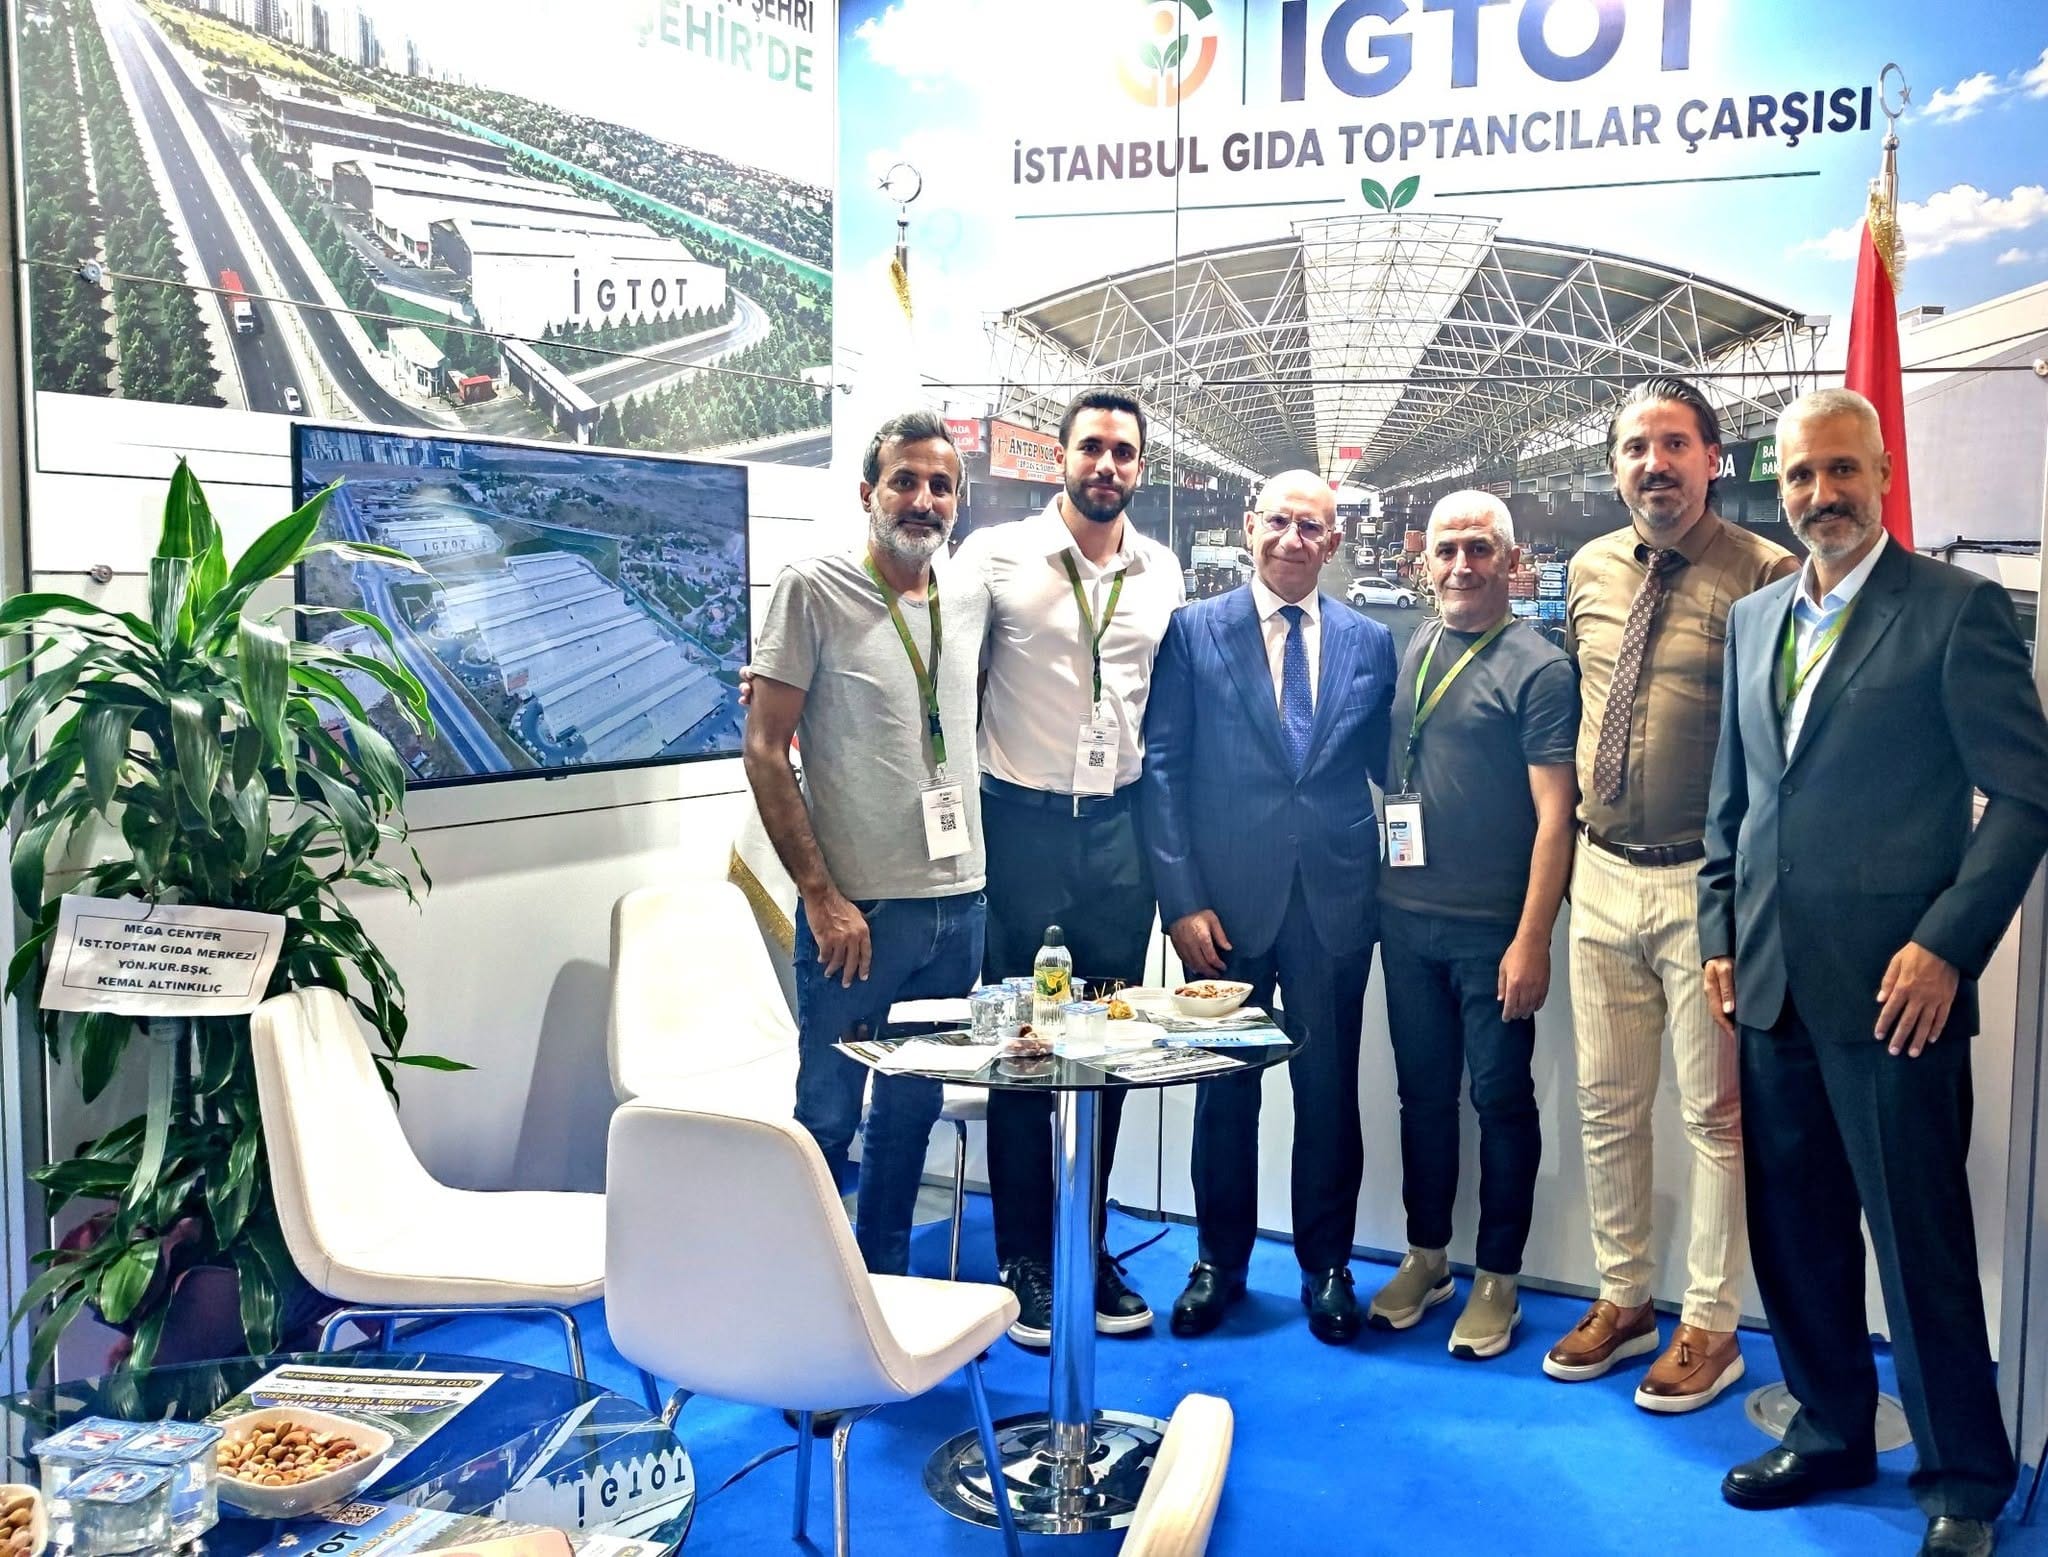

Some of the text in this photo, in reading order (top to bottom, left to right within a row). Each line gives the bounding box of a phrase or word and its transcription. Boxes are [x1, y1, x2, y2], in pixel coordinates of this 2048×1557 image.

[1014, 86, 1872, 184] İSTANBUL GIDA TOPTANCILAR ÇARŞISI
[573, 268, 687, 314] İGTOT
[1009, 438, 1038, 458] ANTEP
[124, 924, 222, 942] MEGA CENTER
[78, 936, 257, 961] İST.TOPTAN GIDA MERKEZİ
[118, 959, 212, 976] YÖN.KUR.BŞK.
[97, 976, 222, 994] KEMAL ALTINKILIÇ
